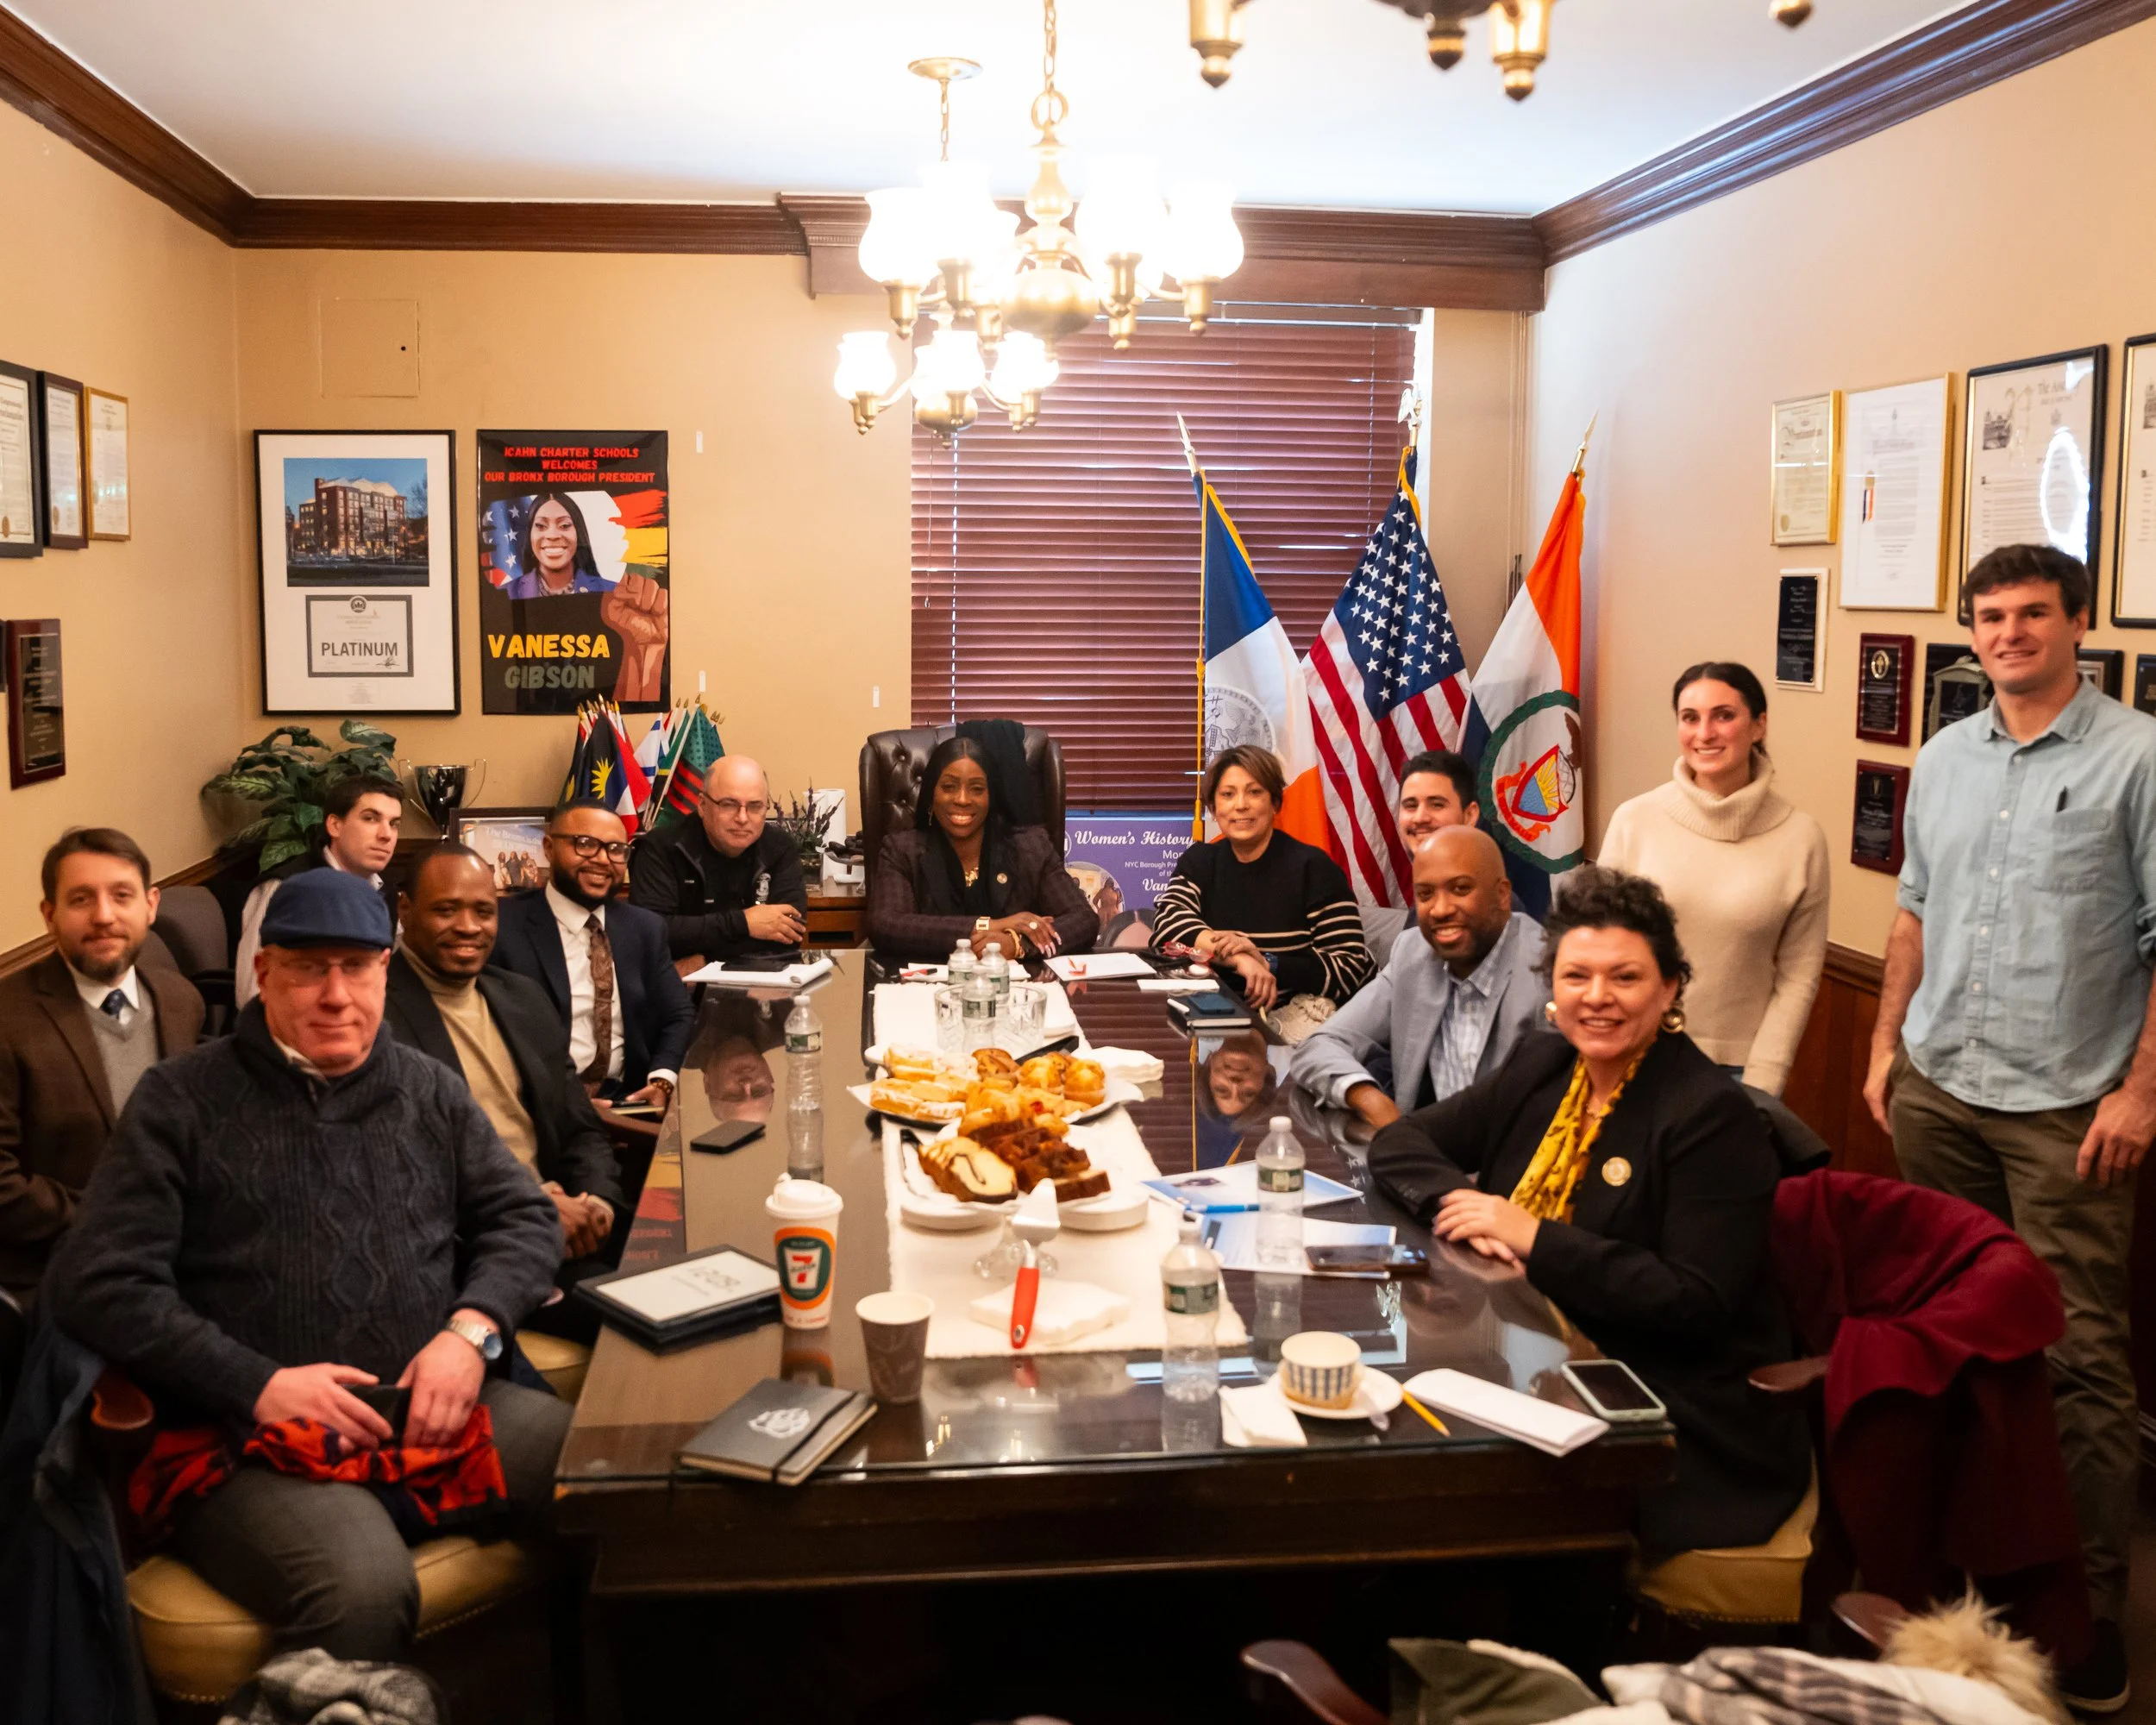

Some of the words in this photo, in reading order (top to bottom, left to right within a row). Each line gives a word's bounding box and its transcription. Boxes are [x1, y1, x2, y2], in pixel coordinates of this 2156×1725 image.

[504, 446, 536, 457] ICAHN
[540, 447, 589, 457] CHARTER
[593, 447, 639, 458] SCHOOLS
[542, 460, 598, 470] WELCOMES
[484, 471, 505, 482] OUR
[508, 472, 544, 482] BRONX
[547, 472, 595, 483] BOROUGH
[599, 472, 655, 483] PRESIDENT
[321, 642, 398, 656] PLATINUM
[487, 634, 611, 658] VANESSA
[505, 665, 595, 689] GIBSON
[1075, 831, 1136, 845] Women's
[1140, 831, 1195, 849] History
[1139, 861, 1166, 870] Borough
[792, 1255, 812, 1283] 7
